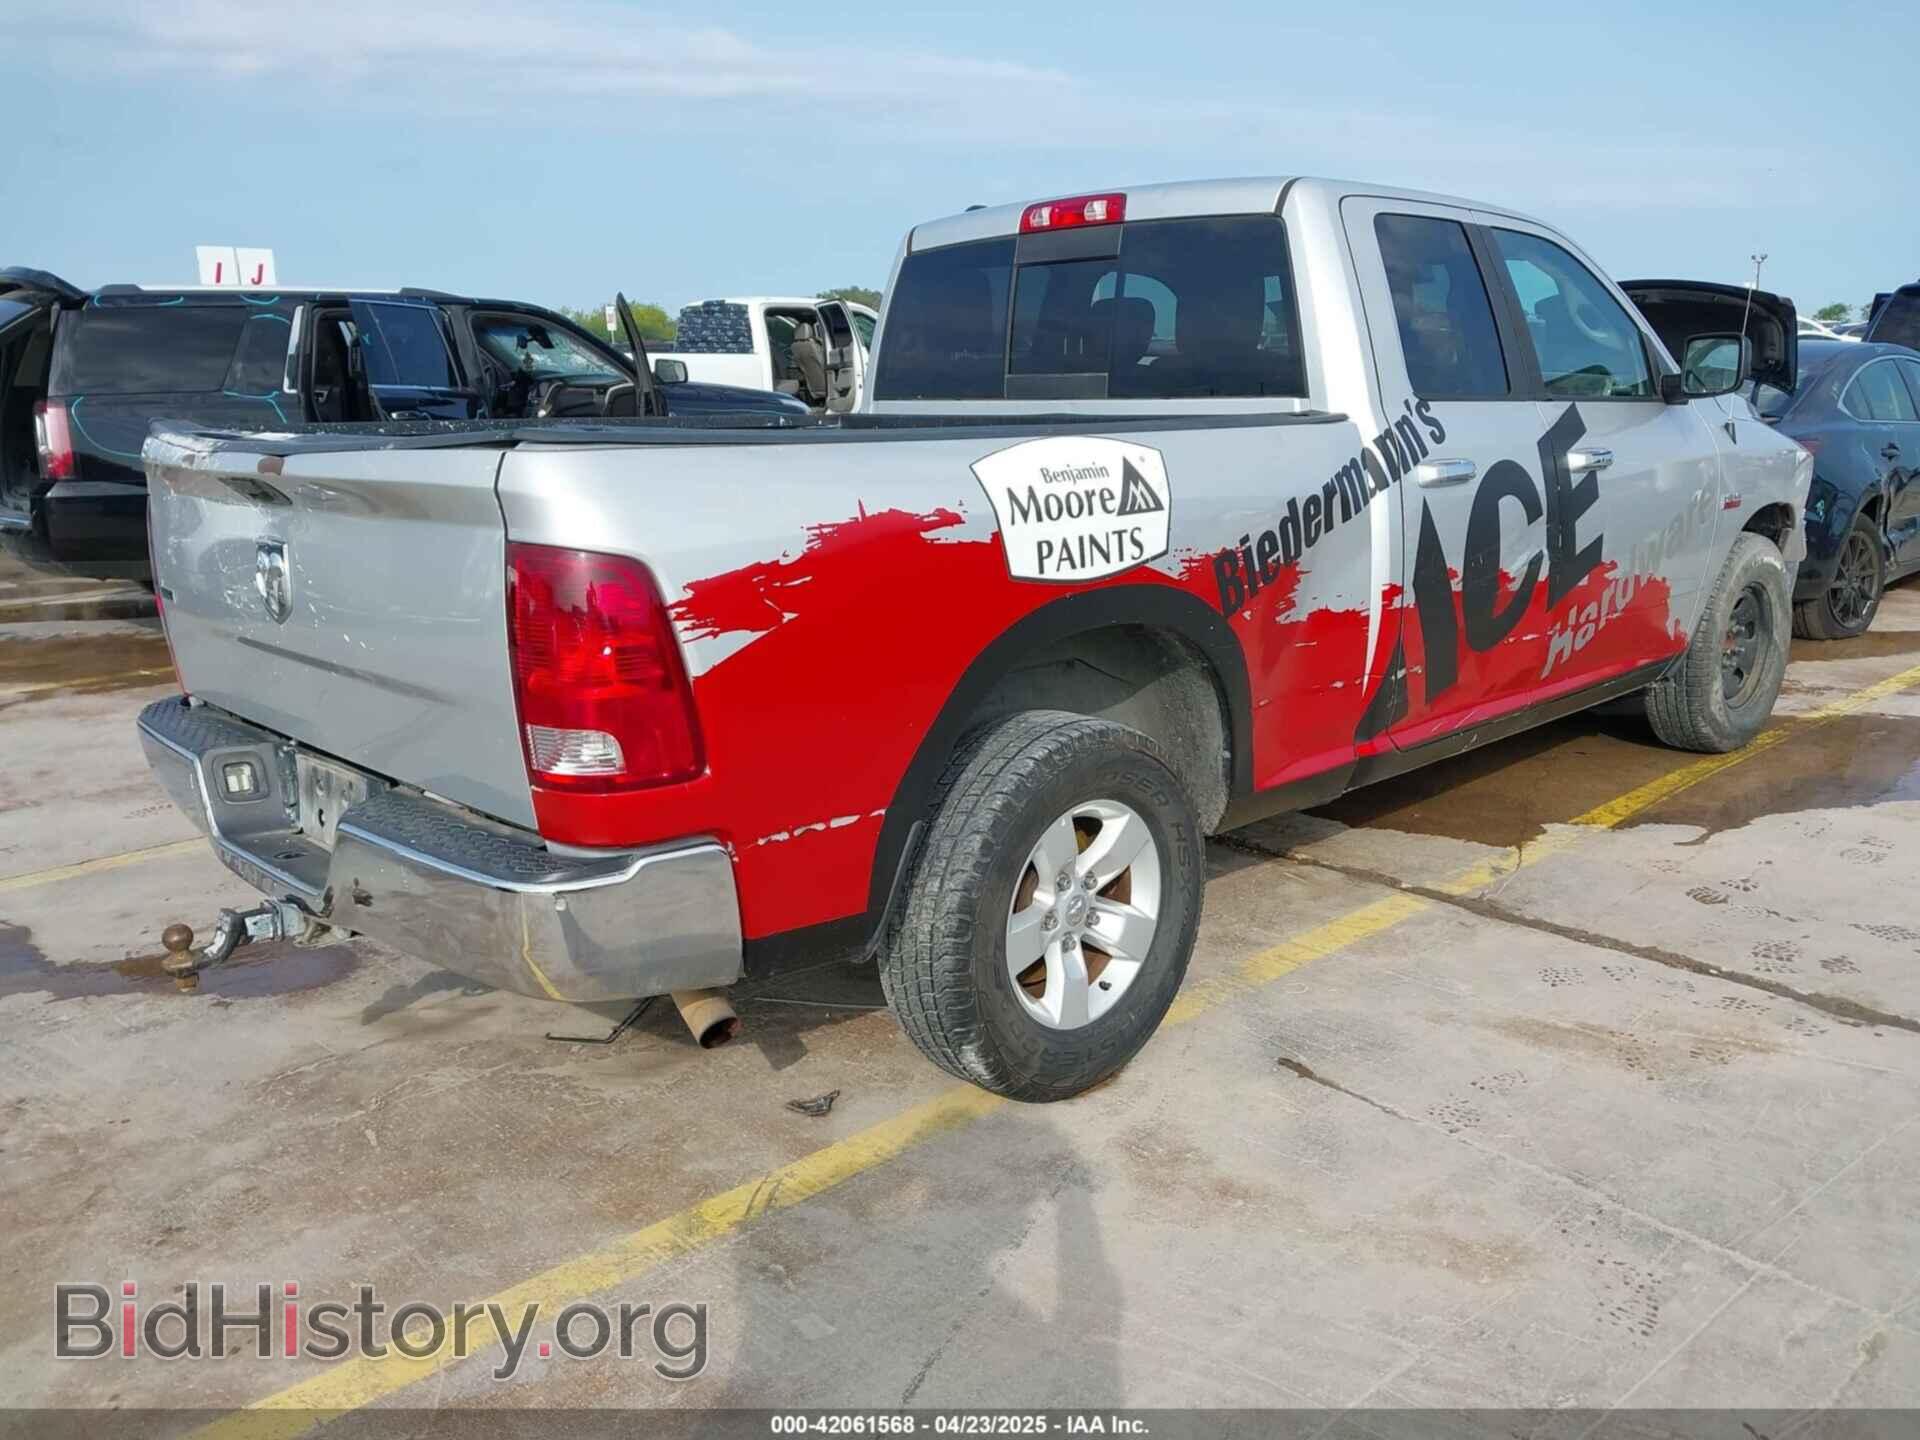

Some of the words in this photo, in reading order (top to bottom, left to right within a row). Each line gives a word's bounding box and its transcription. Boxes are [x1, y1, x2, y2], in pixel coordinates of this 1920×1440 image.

[215, 261, 223, 284] I
[251, 263, 264, 286] J
[1039, 461, 1110, 485] Benjamin
[1006, 485, 1116, 526] Moore
[1212, 397, 1446, 618] Biedermann's
[1036, 526, 1145, 575] PAINTS
[1354, 401, 1604, 742] ACE
